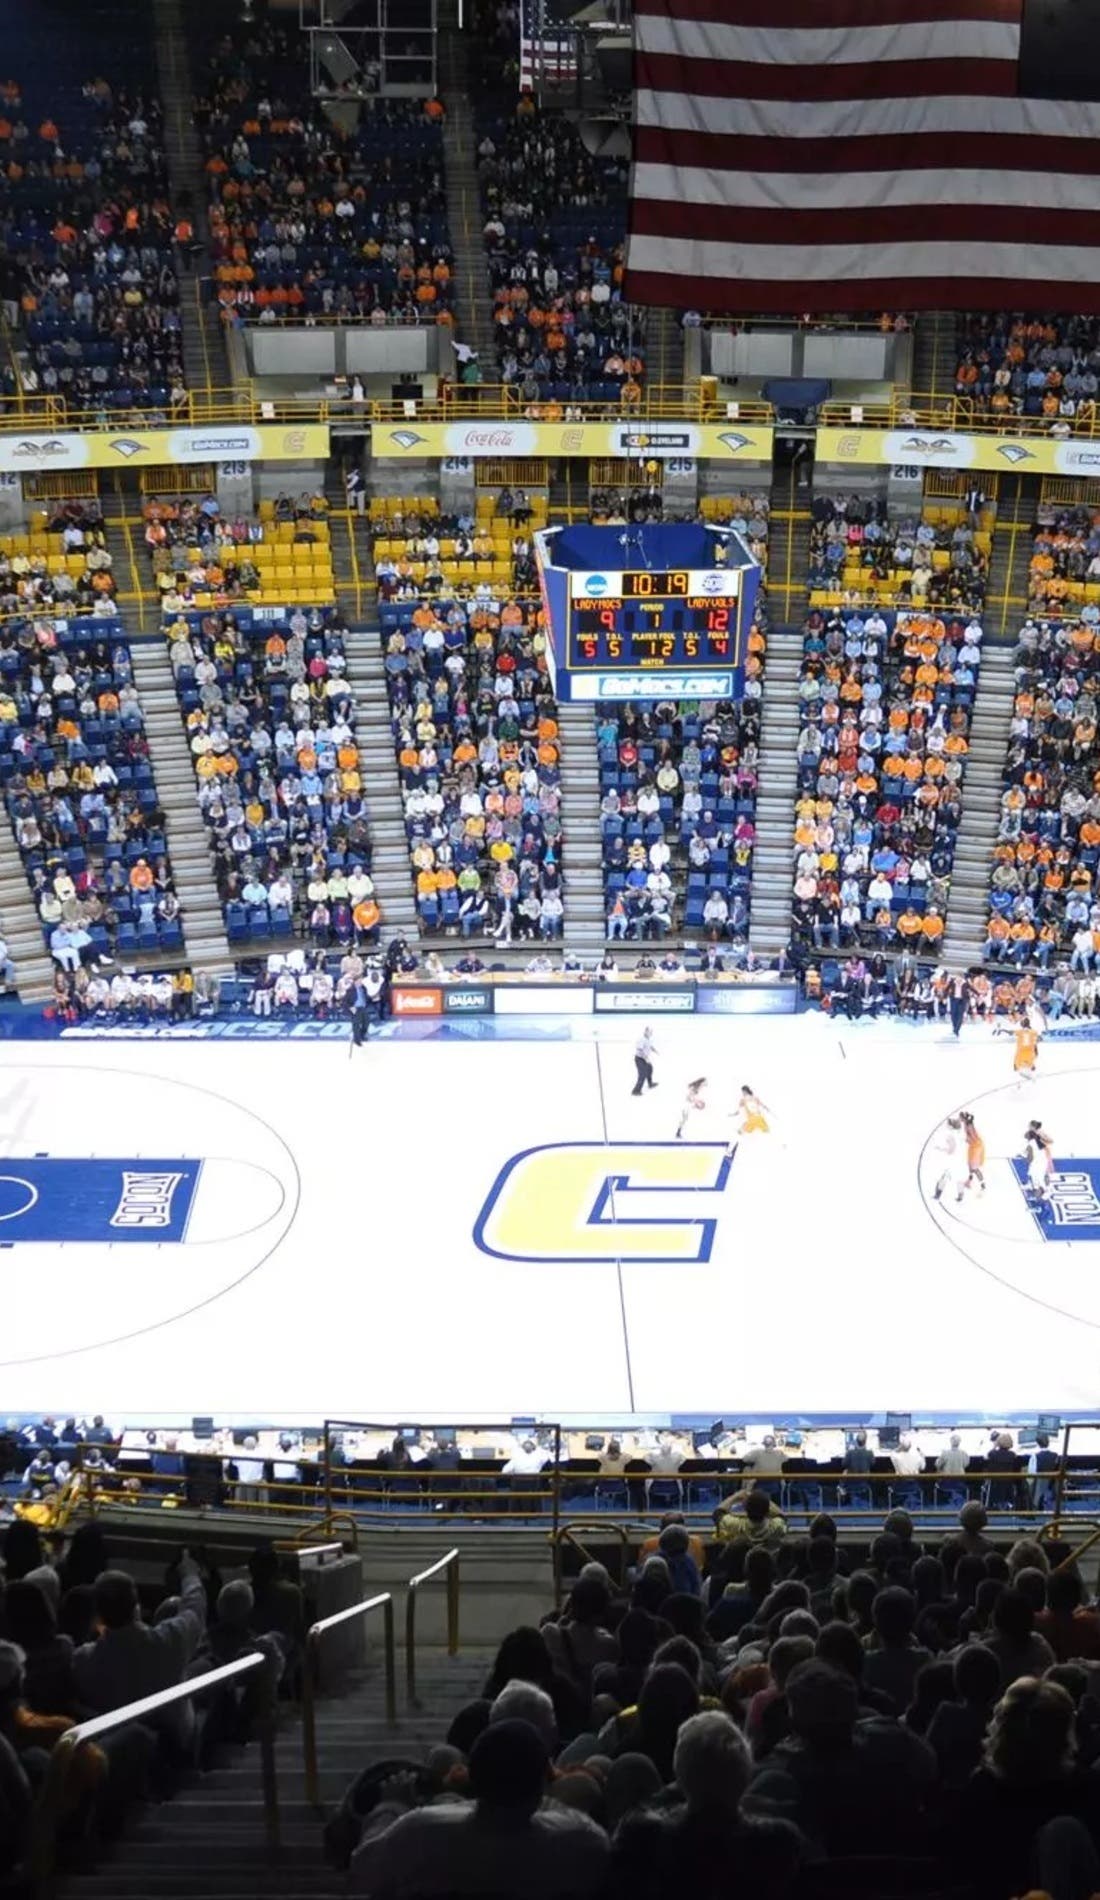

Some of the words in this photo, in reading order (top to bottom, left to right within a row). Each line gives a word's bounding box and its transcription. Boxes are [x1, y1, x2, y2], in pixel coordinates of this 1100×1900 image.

[223, 461, 246, 474] 213
[446, 457, 469, 469] 214
[669, 458, 692, 471] 215
[895, 465, 918, 478] 216
[601, 611, 615, 631] 9
[655, 614, 660, 628] 1
[708, 610, 729, 630] 12
[609, 640, 620, 657] 5
[686, 640, 697, 656] 5
[715, 640, 727, 654] 4
